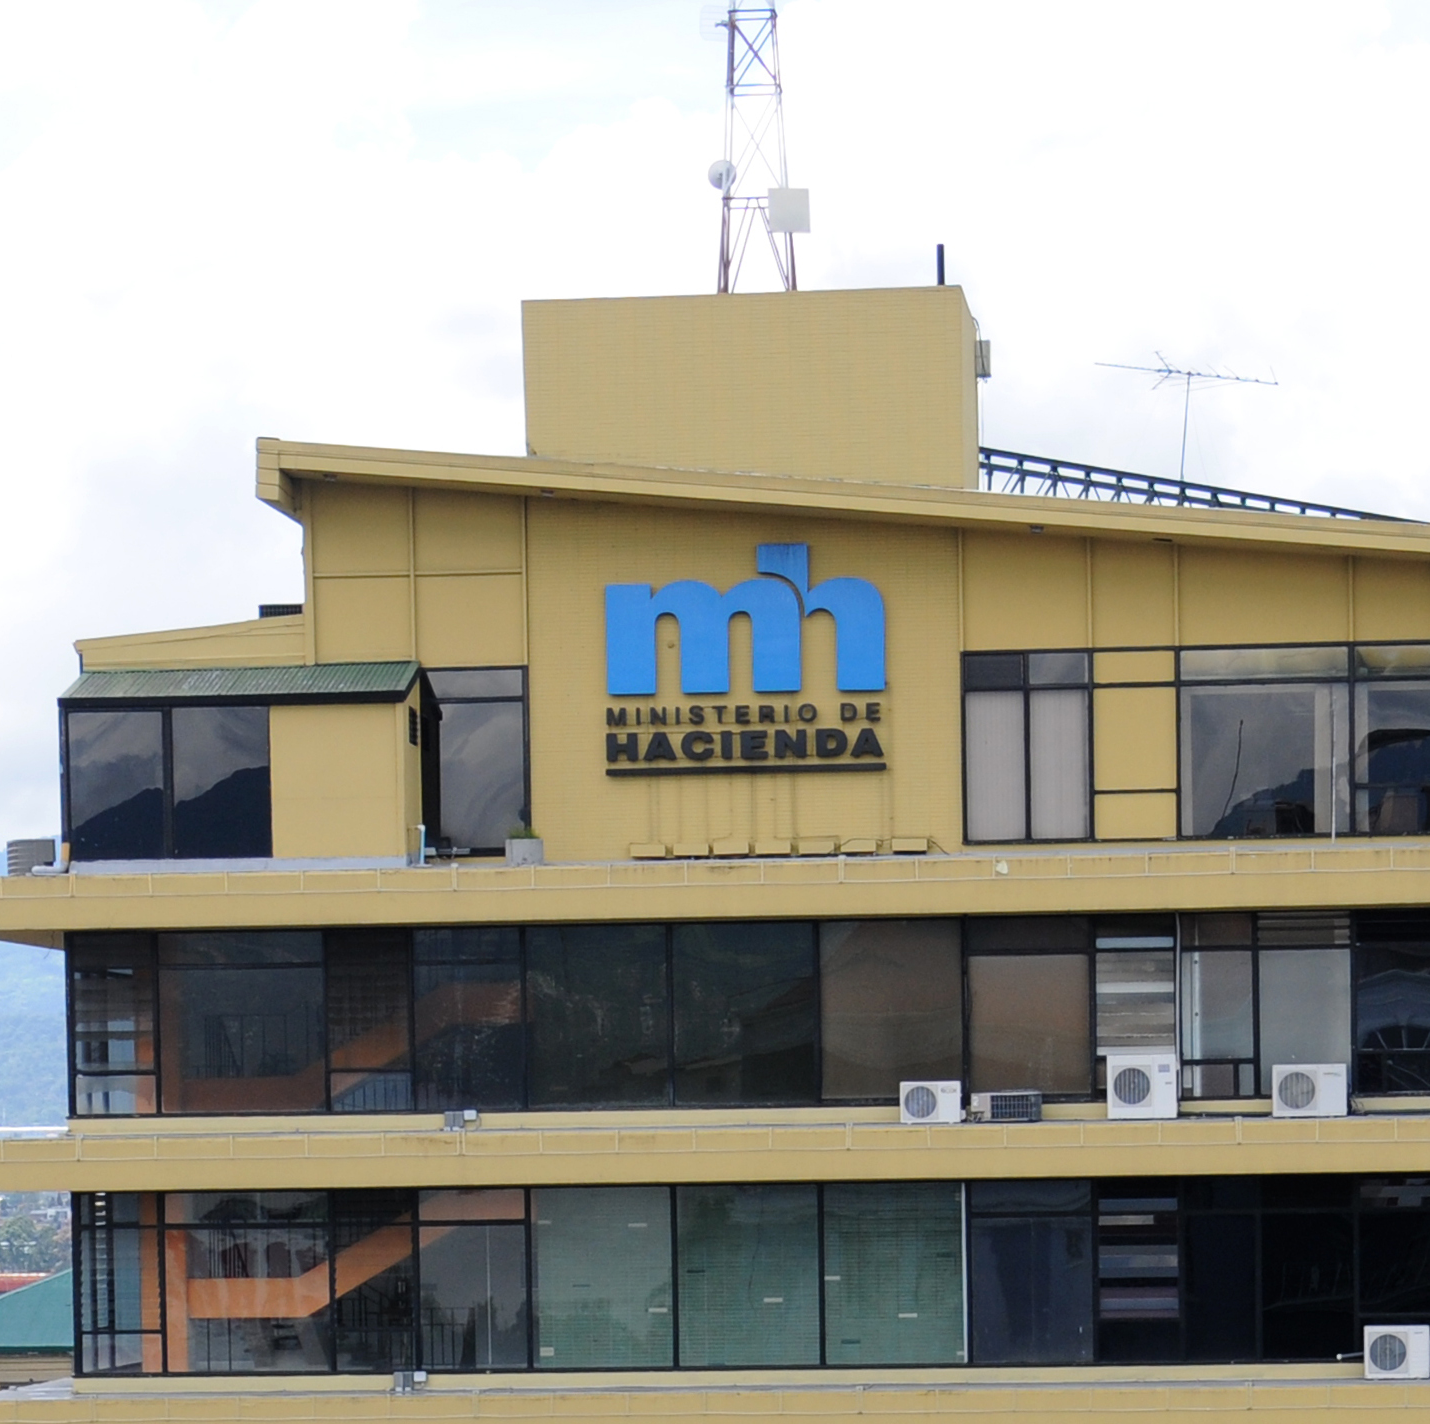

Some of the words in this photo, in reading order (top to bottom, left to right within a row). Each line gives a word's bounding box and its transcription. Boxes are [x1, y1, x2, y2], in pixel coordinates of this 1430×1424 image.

[605, 542, 886, 695] mh
[605, 703, 818, 727] MINISTERIO
[840, 701, 882, 722] DE
[605, 726, 884, 763] HACIENDA
